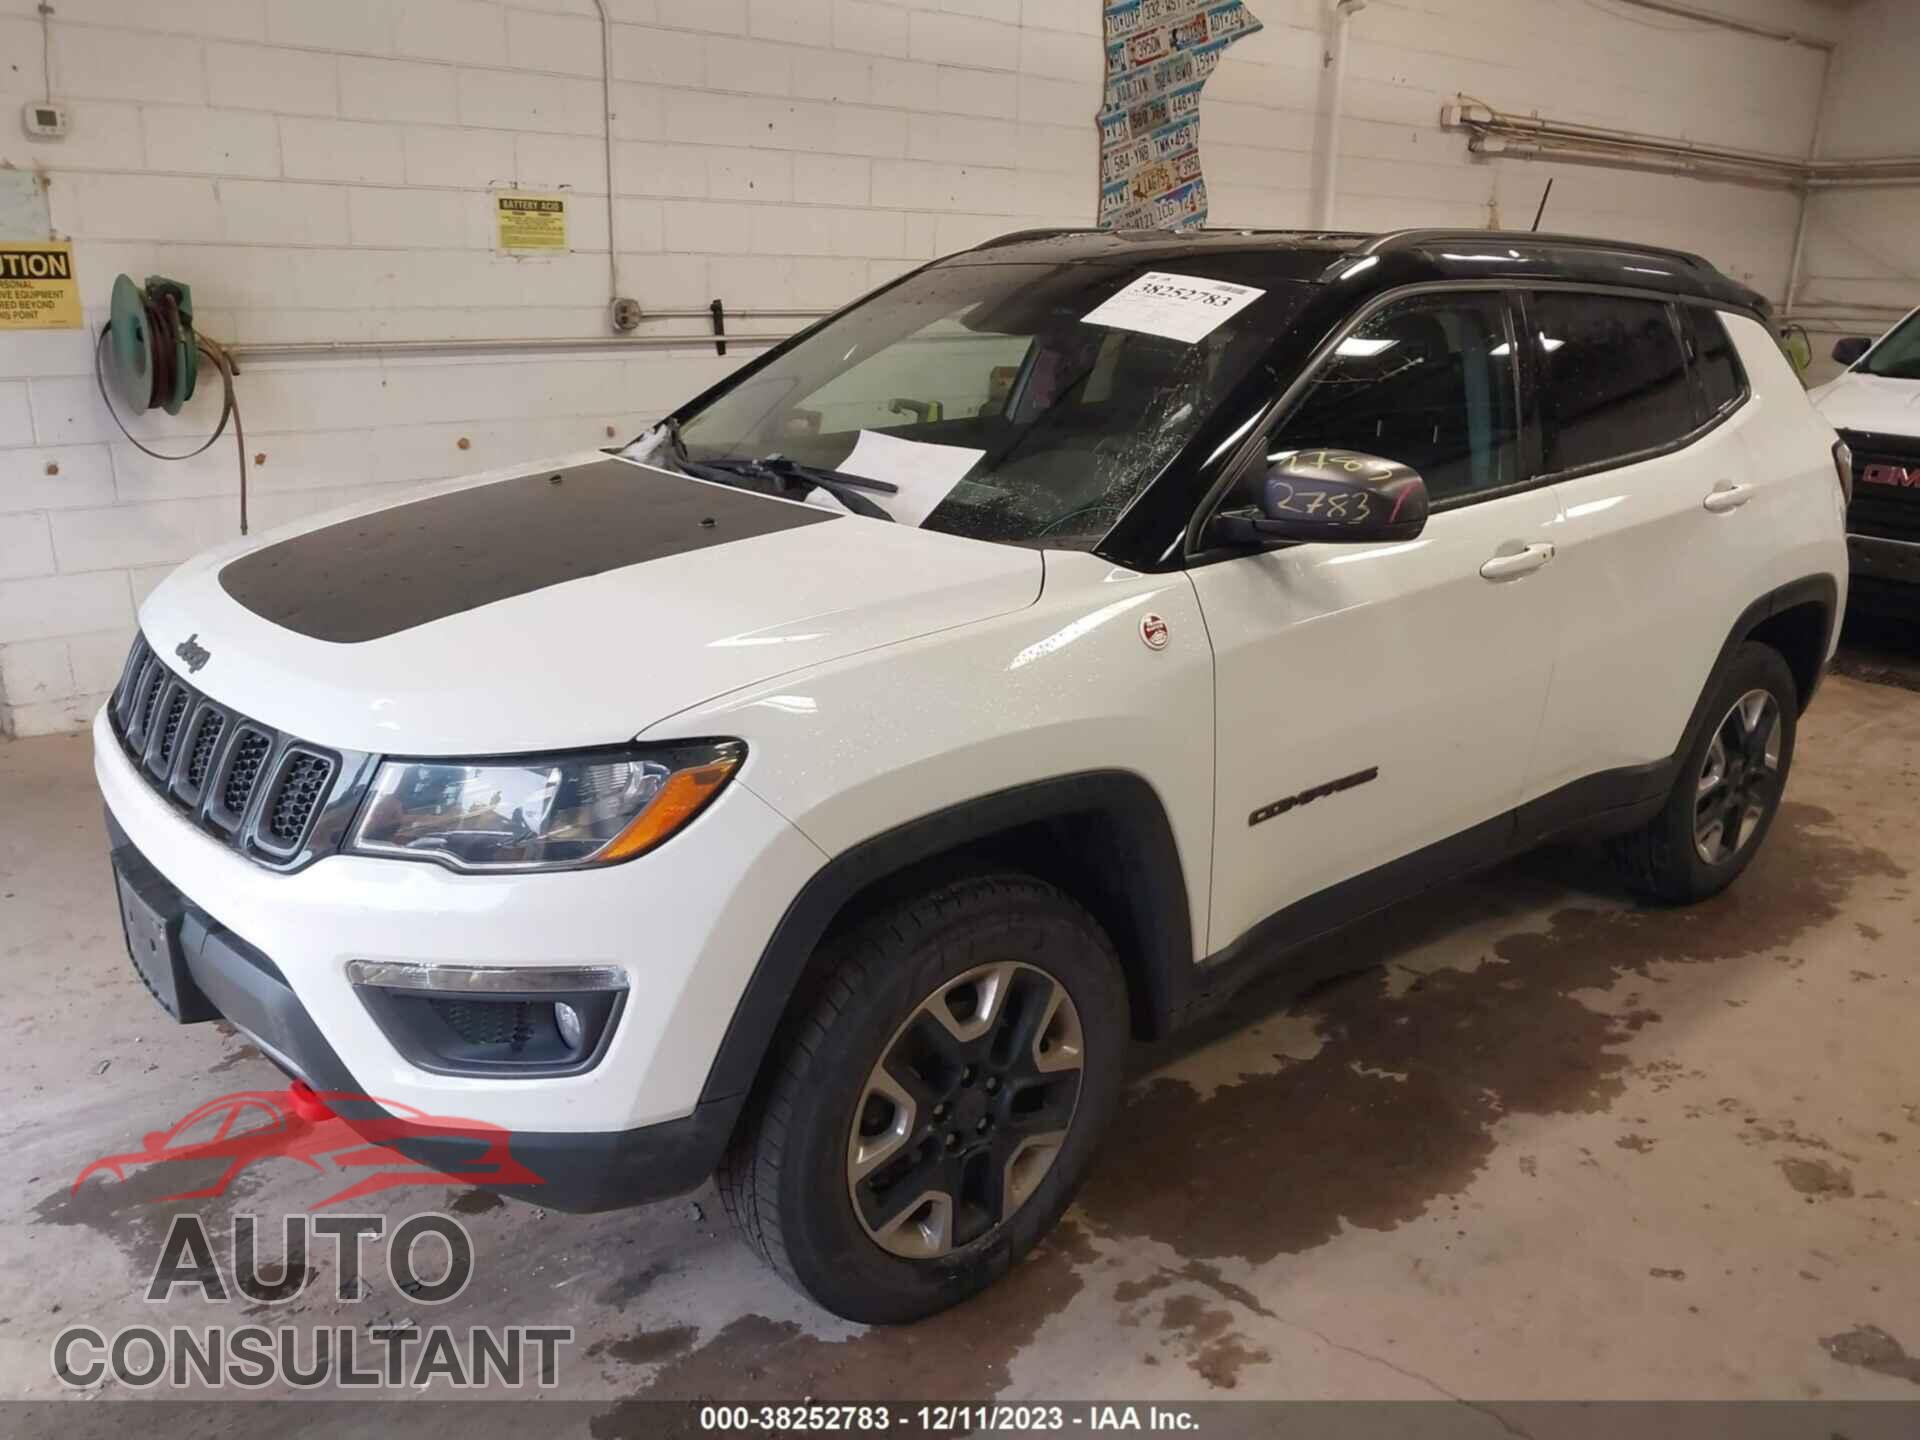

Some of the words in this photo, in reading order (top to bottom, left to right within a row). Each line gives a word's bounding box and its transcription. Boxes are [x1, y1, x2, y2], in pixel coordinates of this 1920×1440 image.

[502, 199, 537, 210] BATTERY
[540, 201, 561, 212] ACID
[15, 290, 64, 300] EQUIPMENT
[1141, 282, 1232, 307] 38252783
[19, 300, 56, 310] BEYOND
[13, 310, 39, 320] POINT
[1271, 482, 1371, 522] 2783
